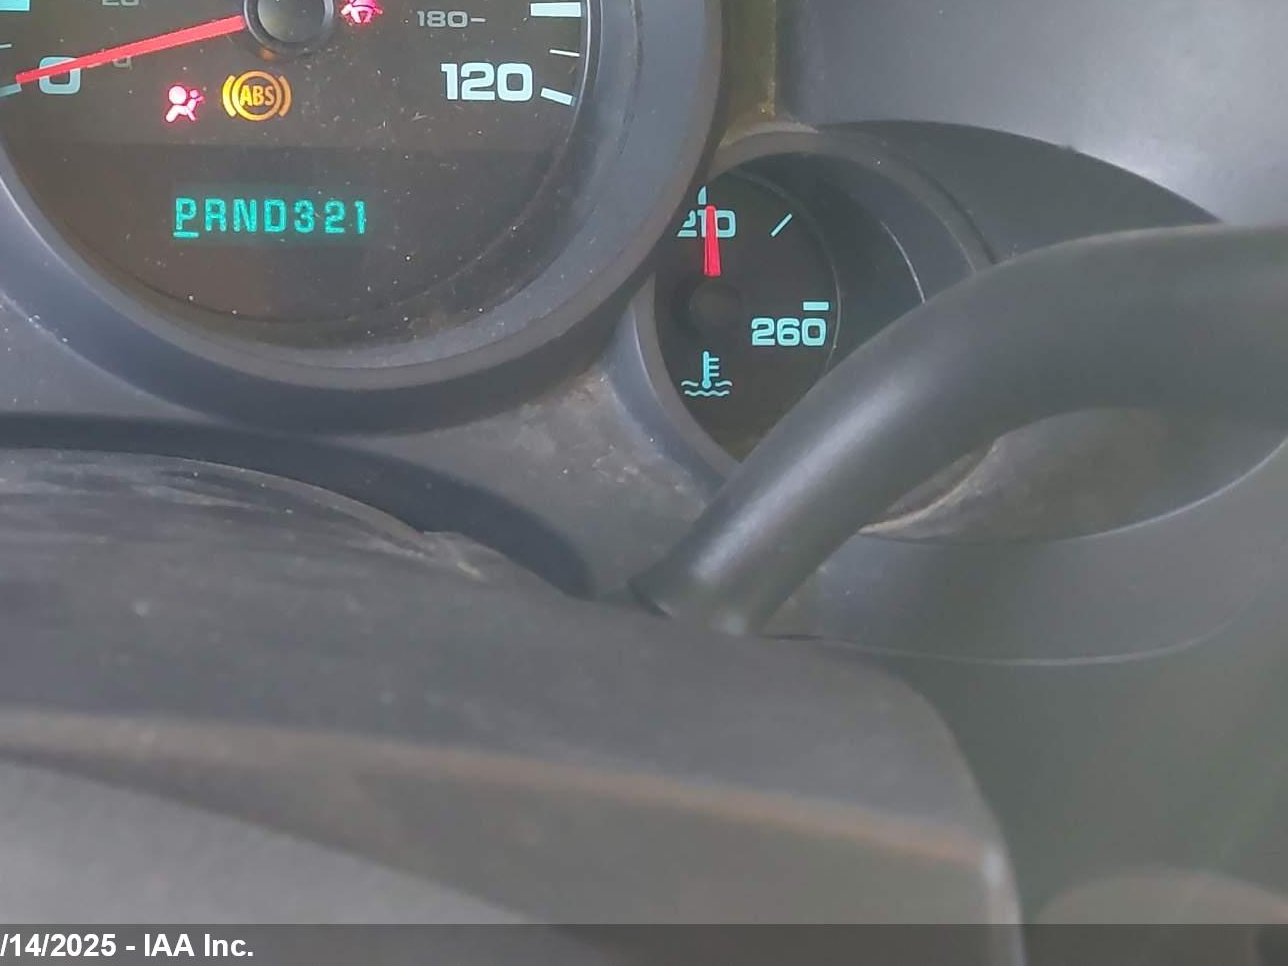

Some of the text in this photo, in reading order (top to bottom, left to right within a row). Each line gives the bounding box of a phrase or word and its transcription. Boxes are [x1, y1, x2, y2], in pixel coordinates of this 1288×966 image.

[417, 11, 468, 28] 180
[440, 62, 534, 102] 120
[239, 85, 276, 107] ABS
[751, 318, 827, 346] 260
